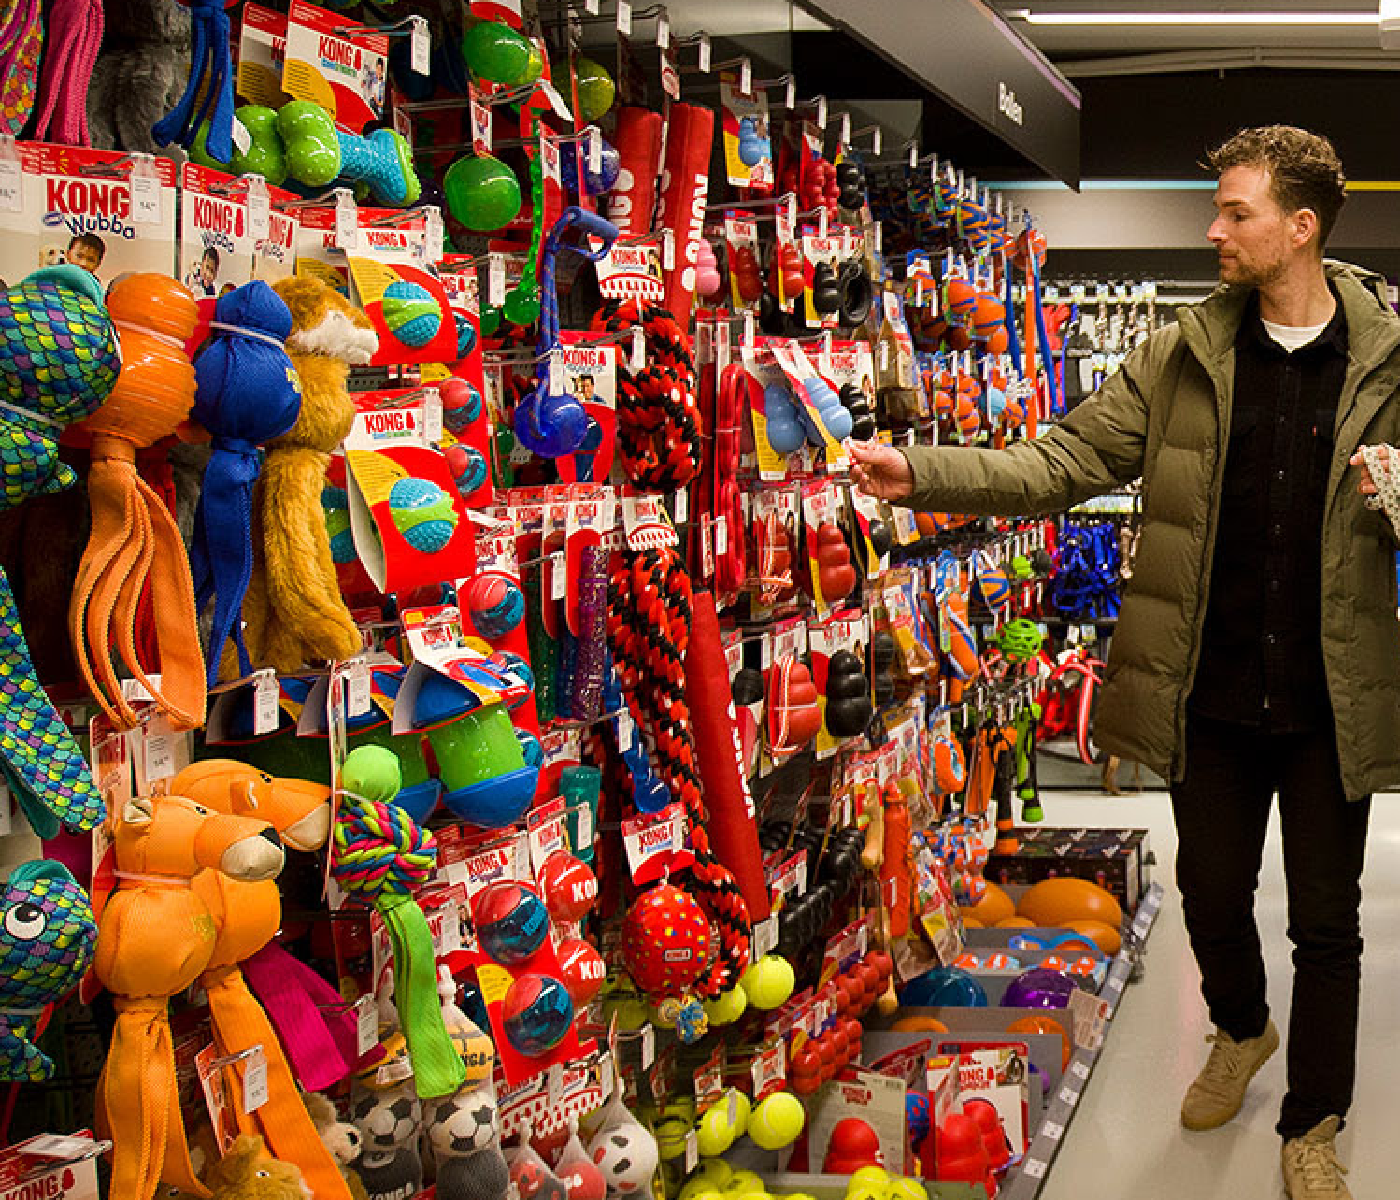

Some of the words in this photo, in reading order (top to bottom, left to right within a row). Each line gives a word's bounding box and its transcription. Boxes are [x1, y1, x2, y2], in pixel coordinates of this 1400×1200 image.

[319, 36, 352, 67] KONG
[47, 179, 130, 219] KONG
[65, 213, 136, 239] Wubba
[193, 196, 233, 235] KONG
[364, 413, 405, 434] KONG
